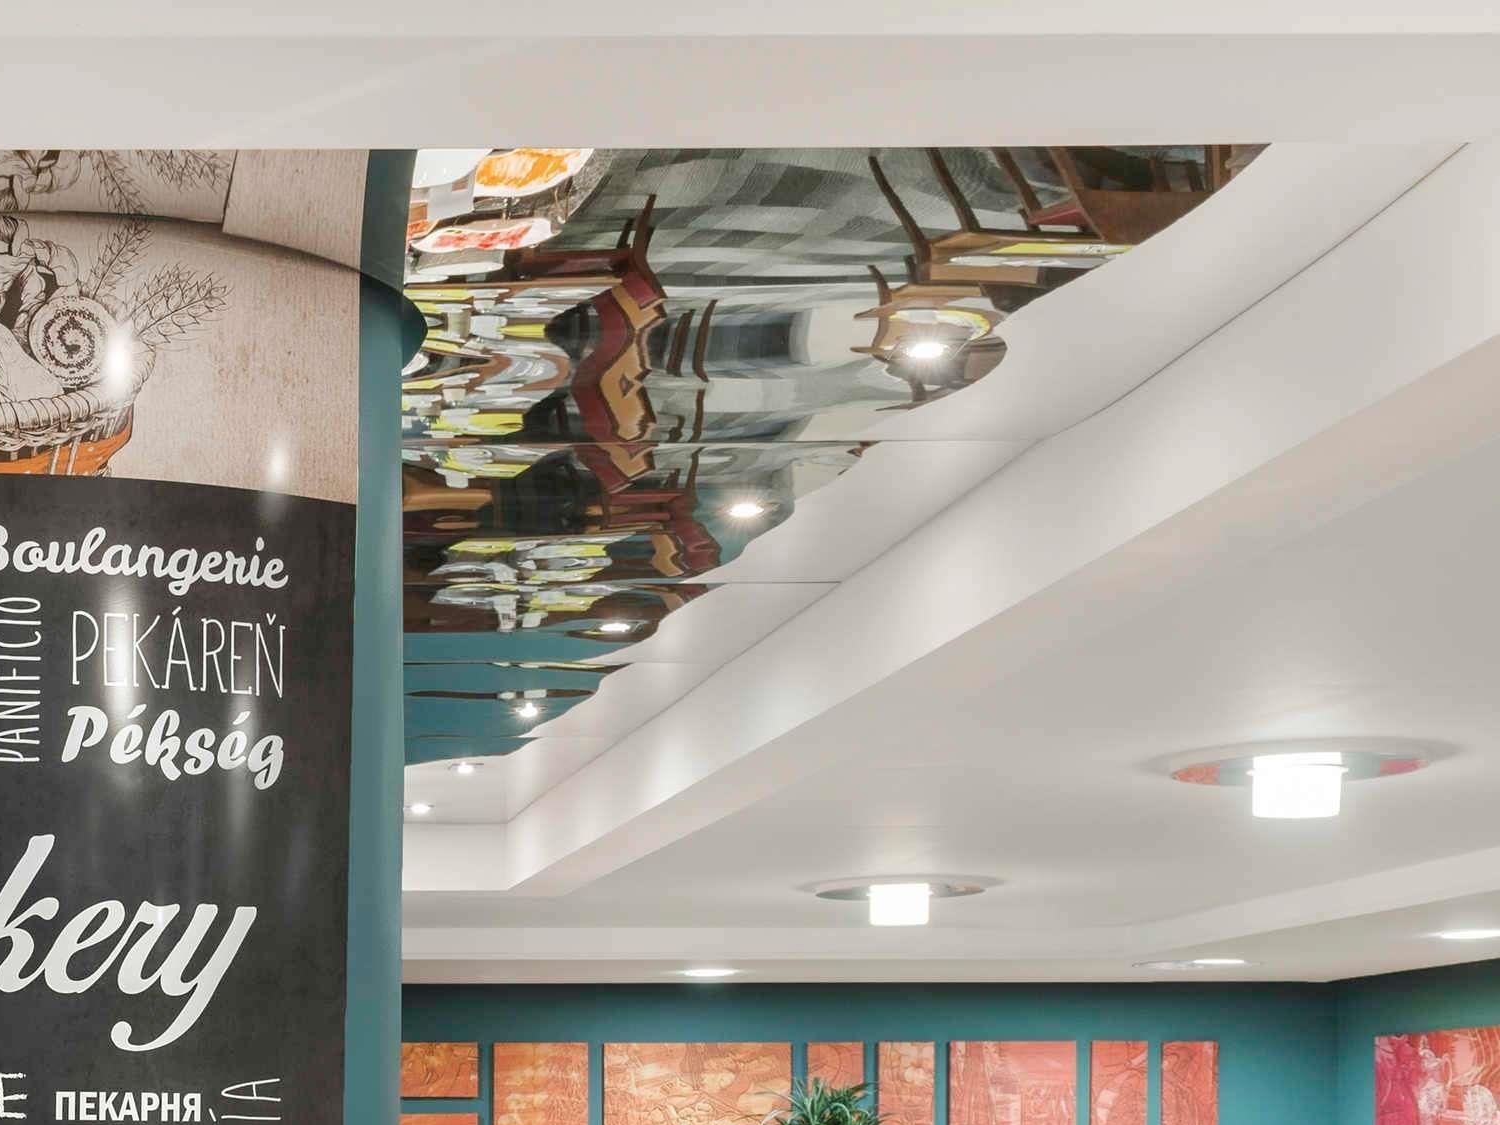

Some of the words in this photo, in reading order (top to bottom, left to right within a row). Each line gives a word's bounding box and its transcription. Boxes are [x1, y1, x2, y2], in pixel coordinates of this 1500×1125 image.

[71, 605, 286, 699] PEKÁREŇ
[61, 704, 284, 790] Pékség
[55, 1090, 202, 1123] ПЕКАРНЯ
